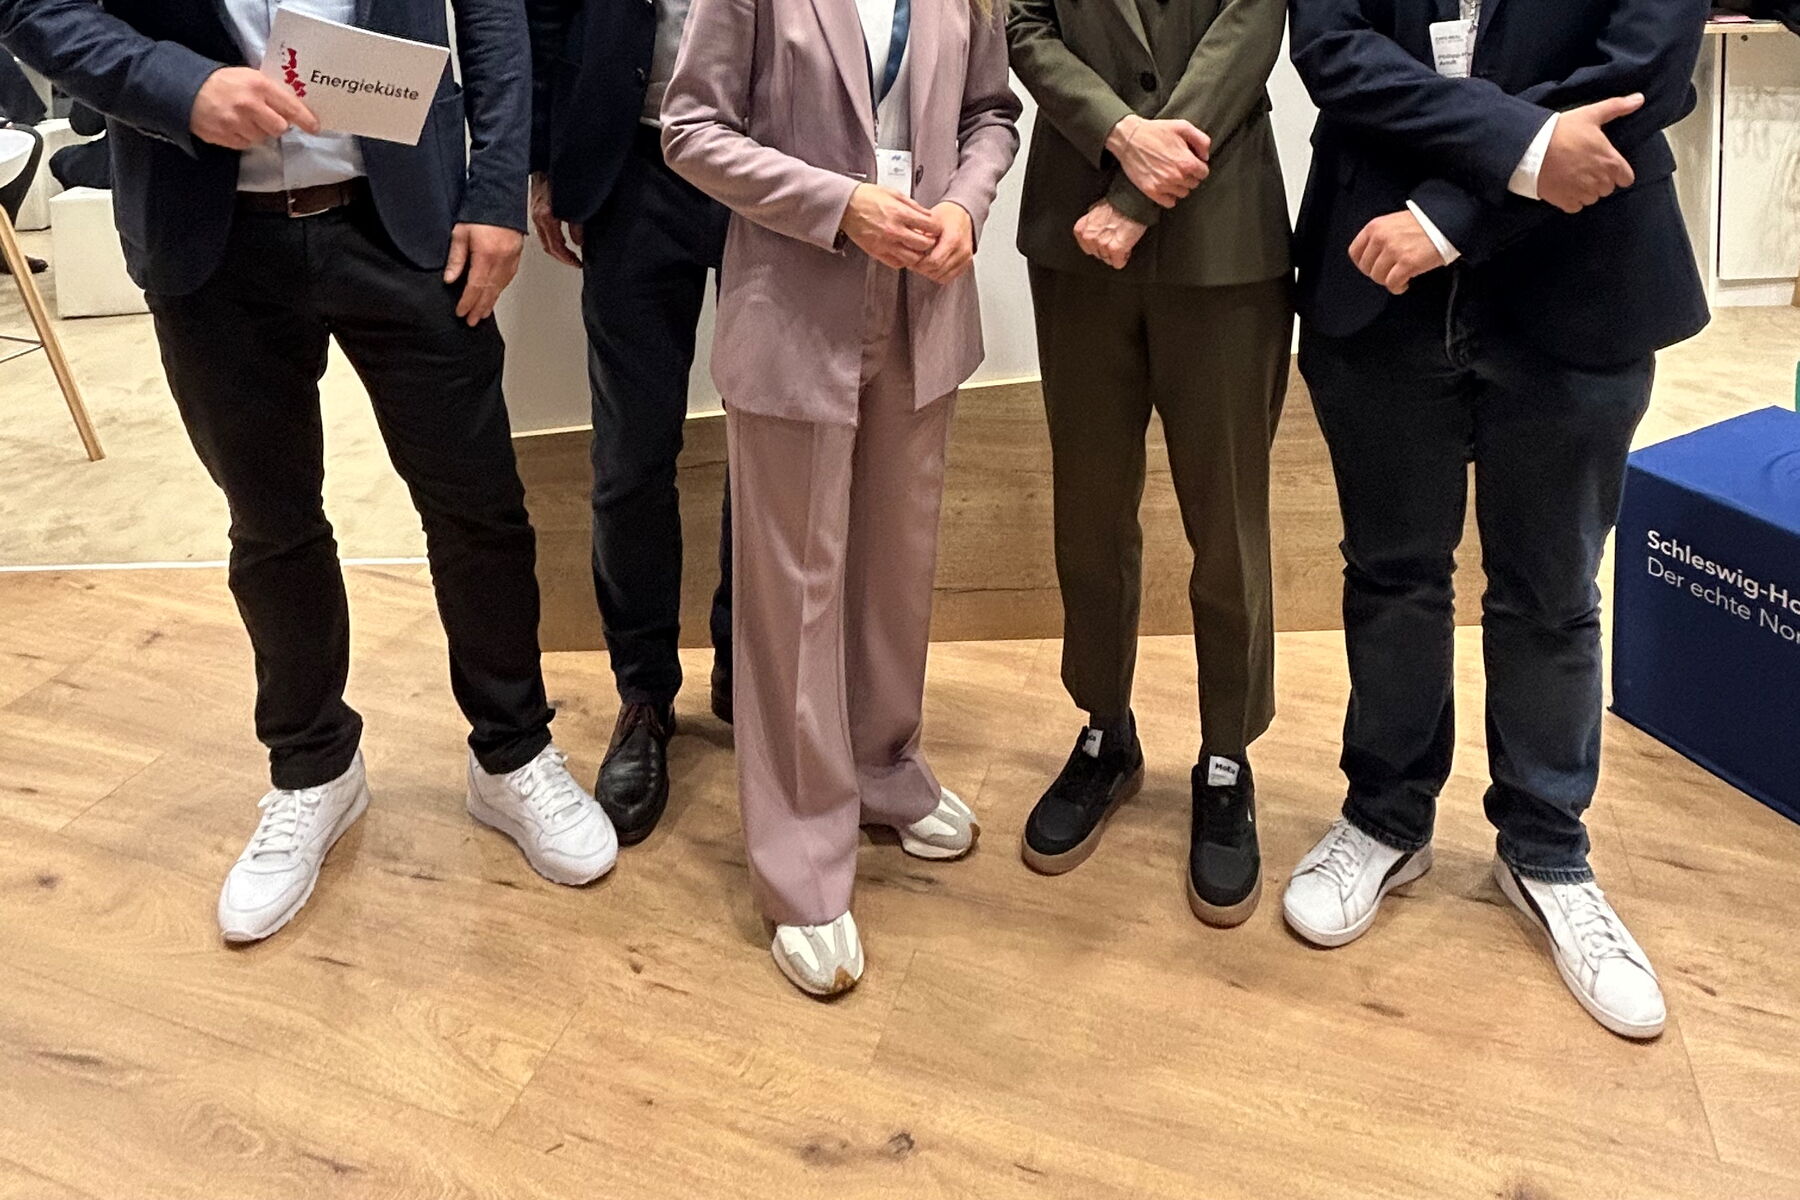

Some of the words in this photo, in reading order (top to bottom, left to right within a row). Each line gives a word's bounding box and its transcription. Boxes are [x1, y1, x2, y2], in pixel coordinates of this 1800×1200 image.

[310, 69, 420, 101] Energieküste
[1647, 556, 1685, 588] Der
[1690, 582, 1751, 620] echte
